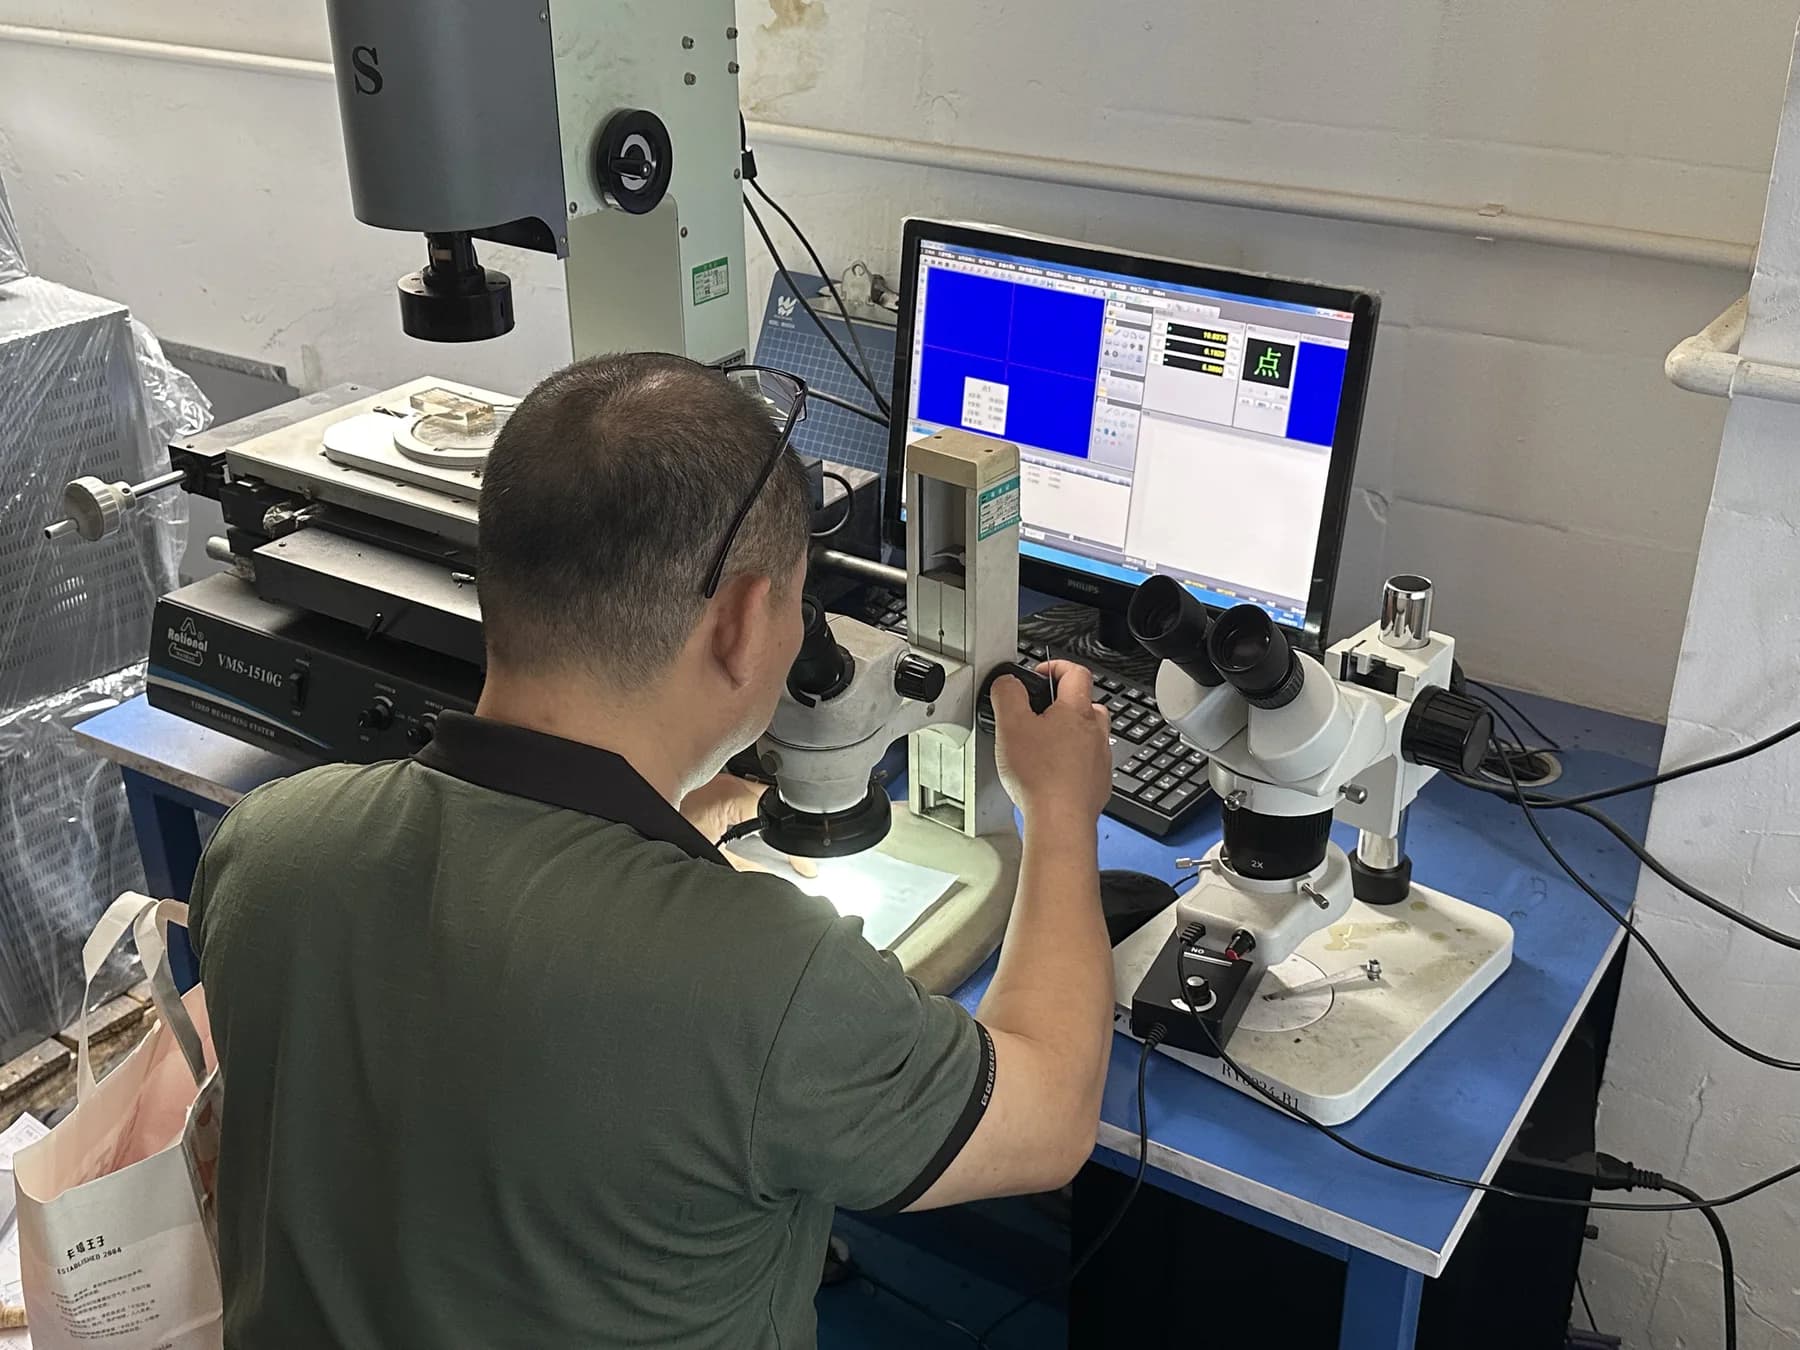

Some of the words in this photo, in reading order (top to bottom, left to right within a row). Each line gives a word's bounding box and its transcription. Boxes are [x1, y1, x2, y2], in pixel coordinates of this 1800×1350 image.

[352, 46, 383, 95] S
[1253, 347, 1282, 379] 点
[168, 627, 208, 652] Rational
[218, 653, 282, 687] VMS-1510G
